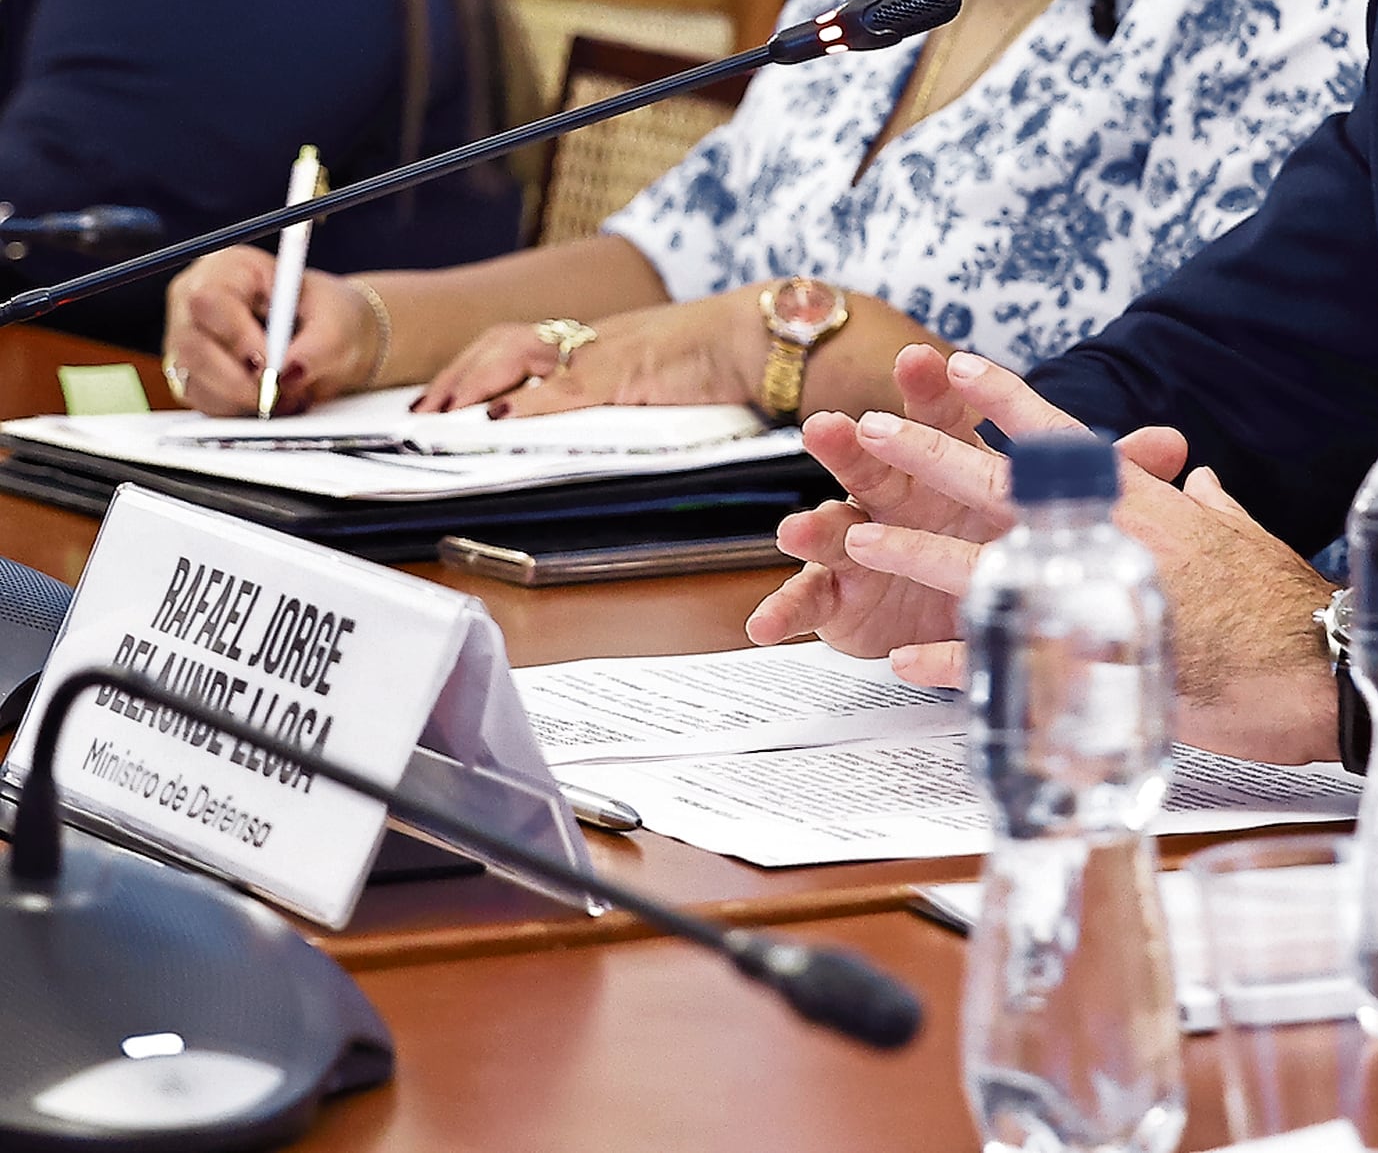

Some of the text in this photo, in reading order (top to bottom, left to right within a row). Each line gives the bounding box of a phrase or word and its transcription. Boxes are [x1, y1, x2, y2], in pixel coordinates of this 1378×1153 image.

[151, 556, 356, 696] RAFAEL JORGE
[82, 737, 272, 848] Ministro de Defensa
